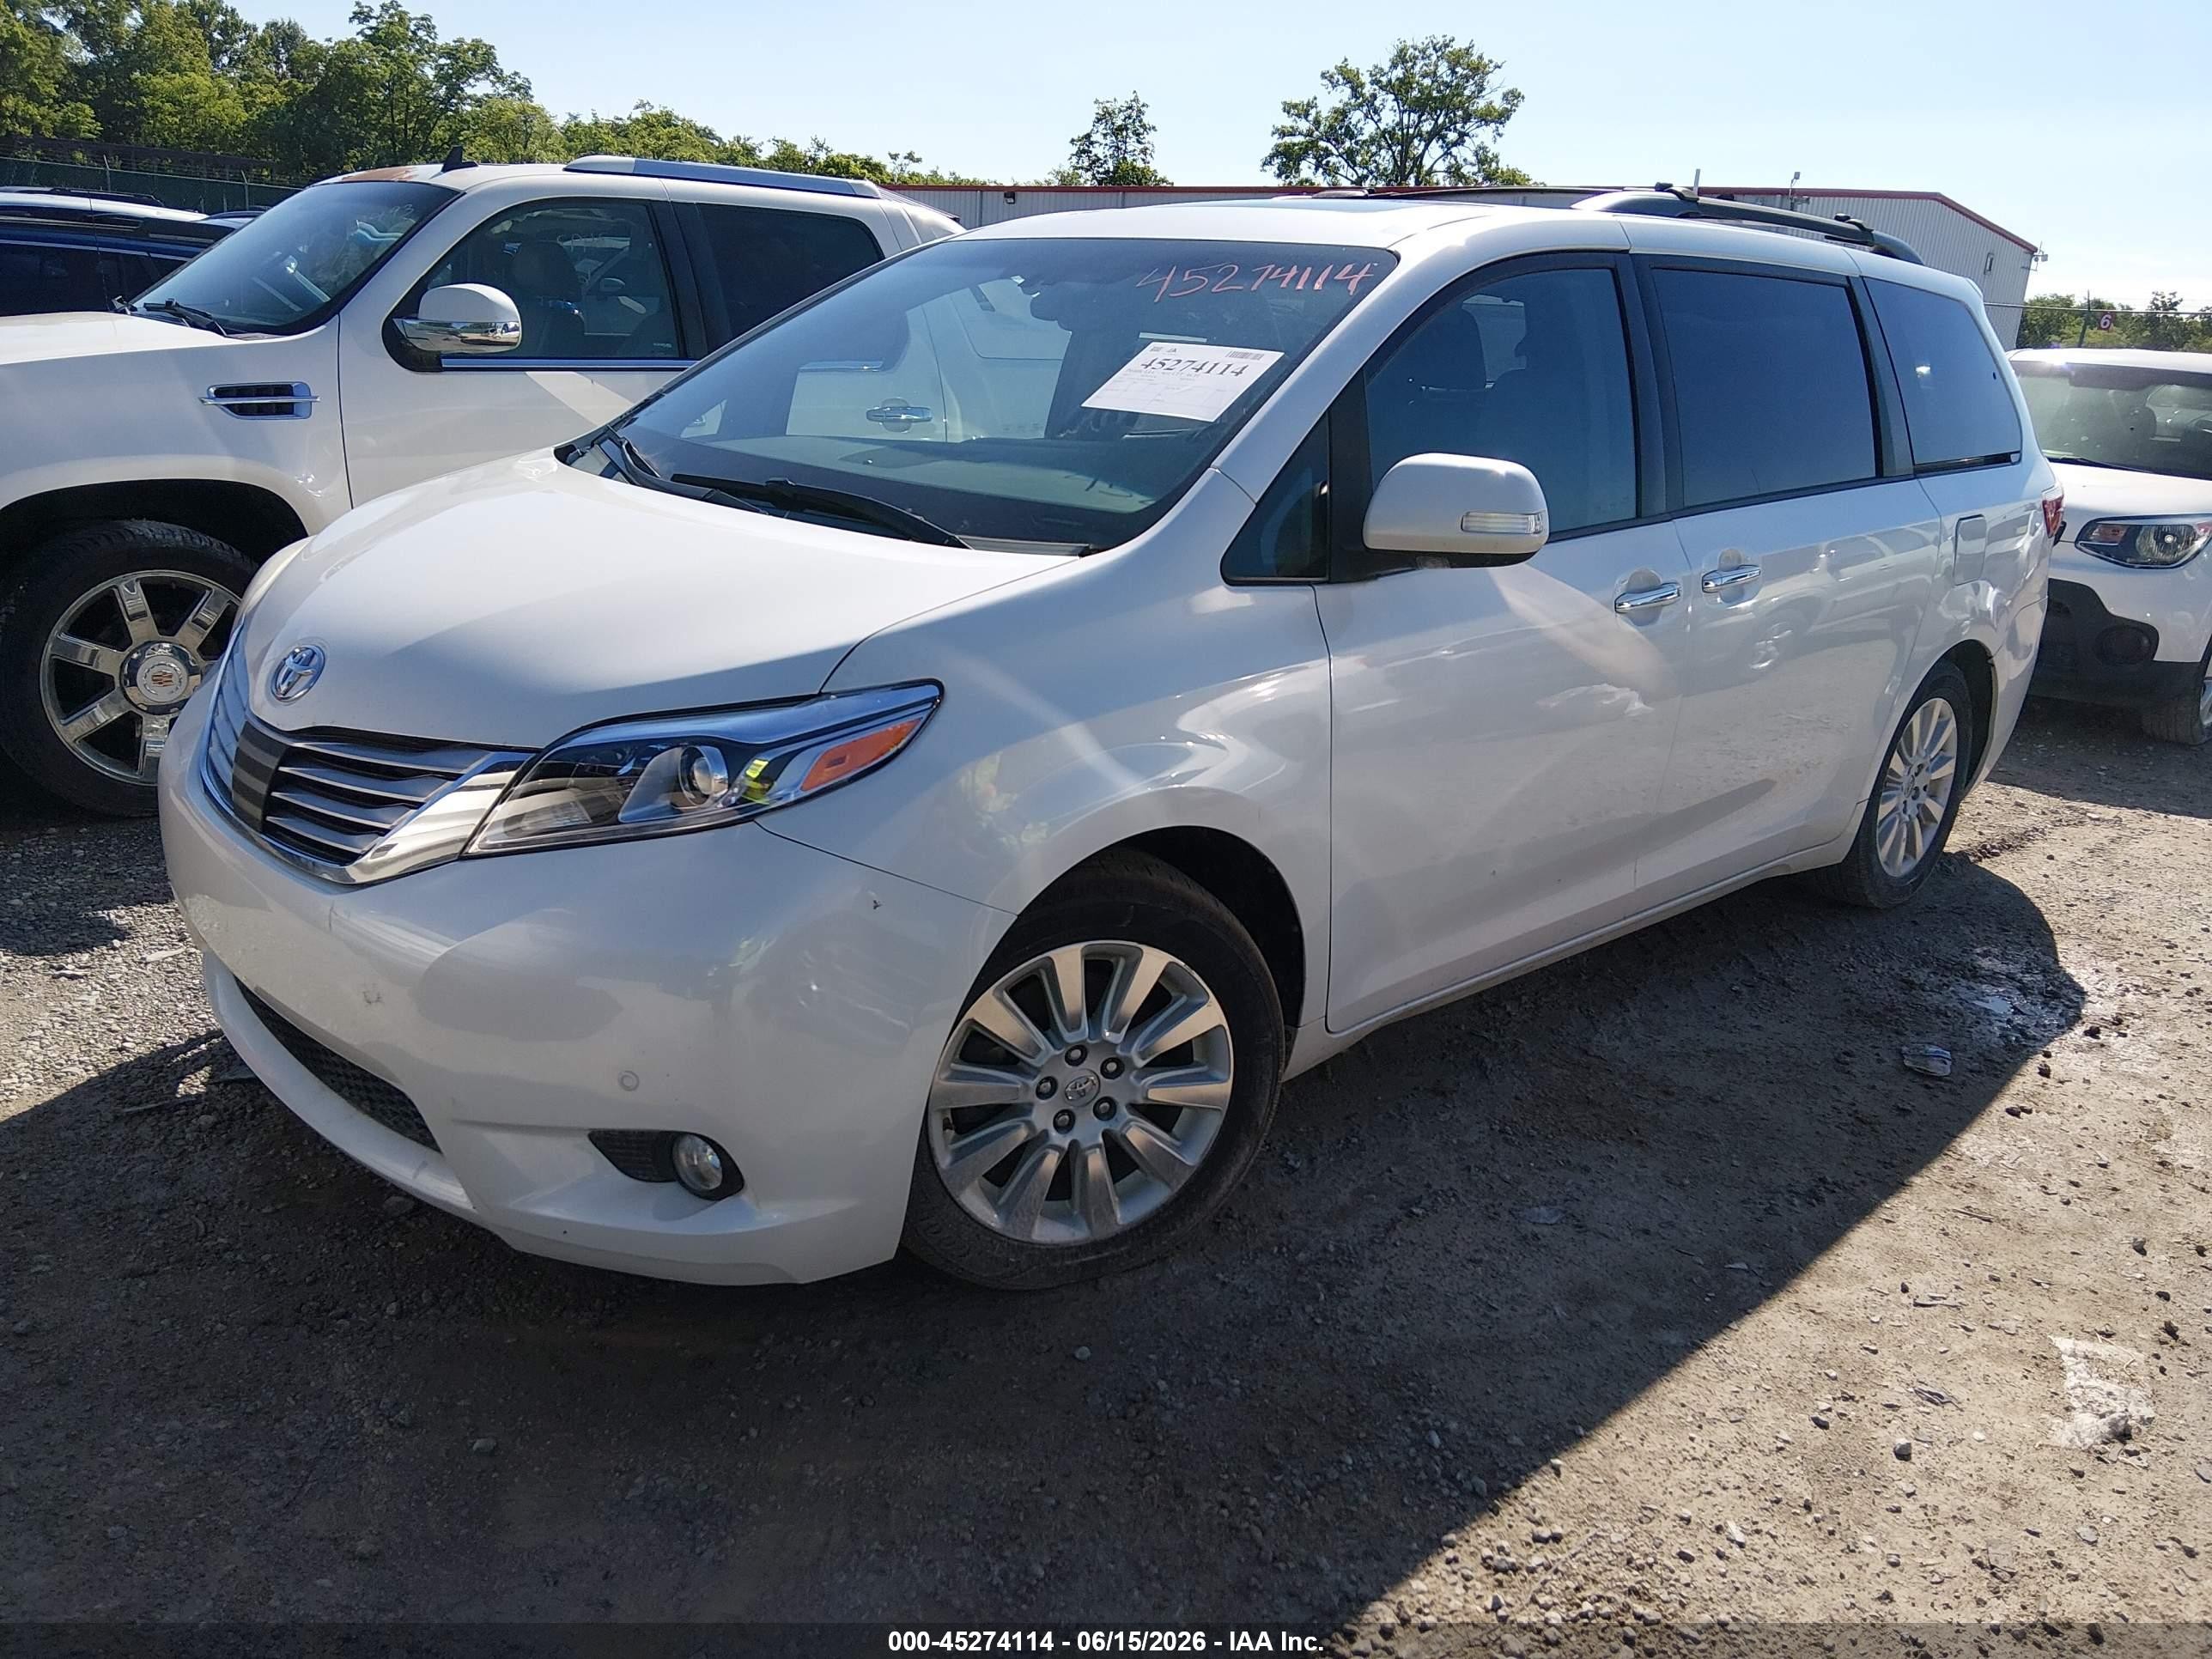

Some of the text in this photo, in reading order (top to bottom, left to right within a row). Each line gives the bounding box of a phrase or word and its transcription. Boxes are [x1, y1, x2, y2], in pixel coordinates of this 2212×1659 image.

[1135, 262, 1375, 303] 45274114
[2100, 313, 2112, 329] 6
[1139, 356, 1249, 377] 45274114
